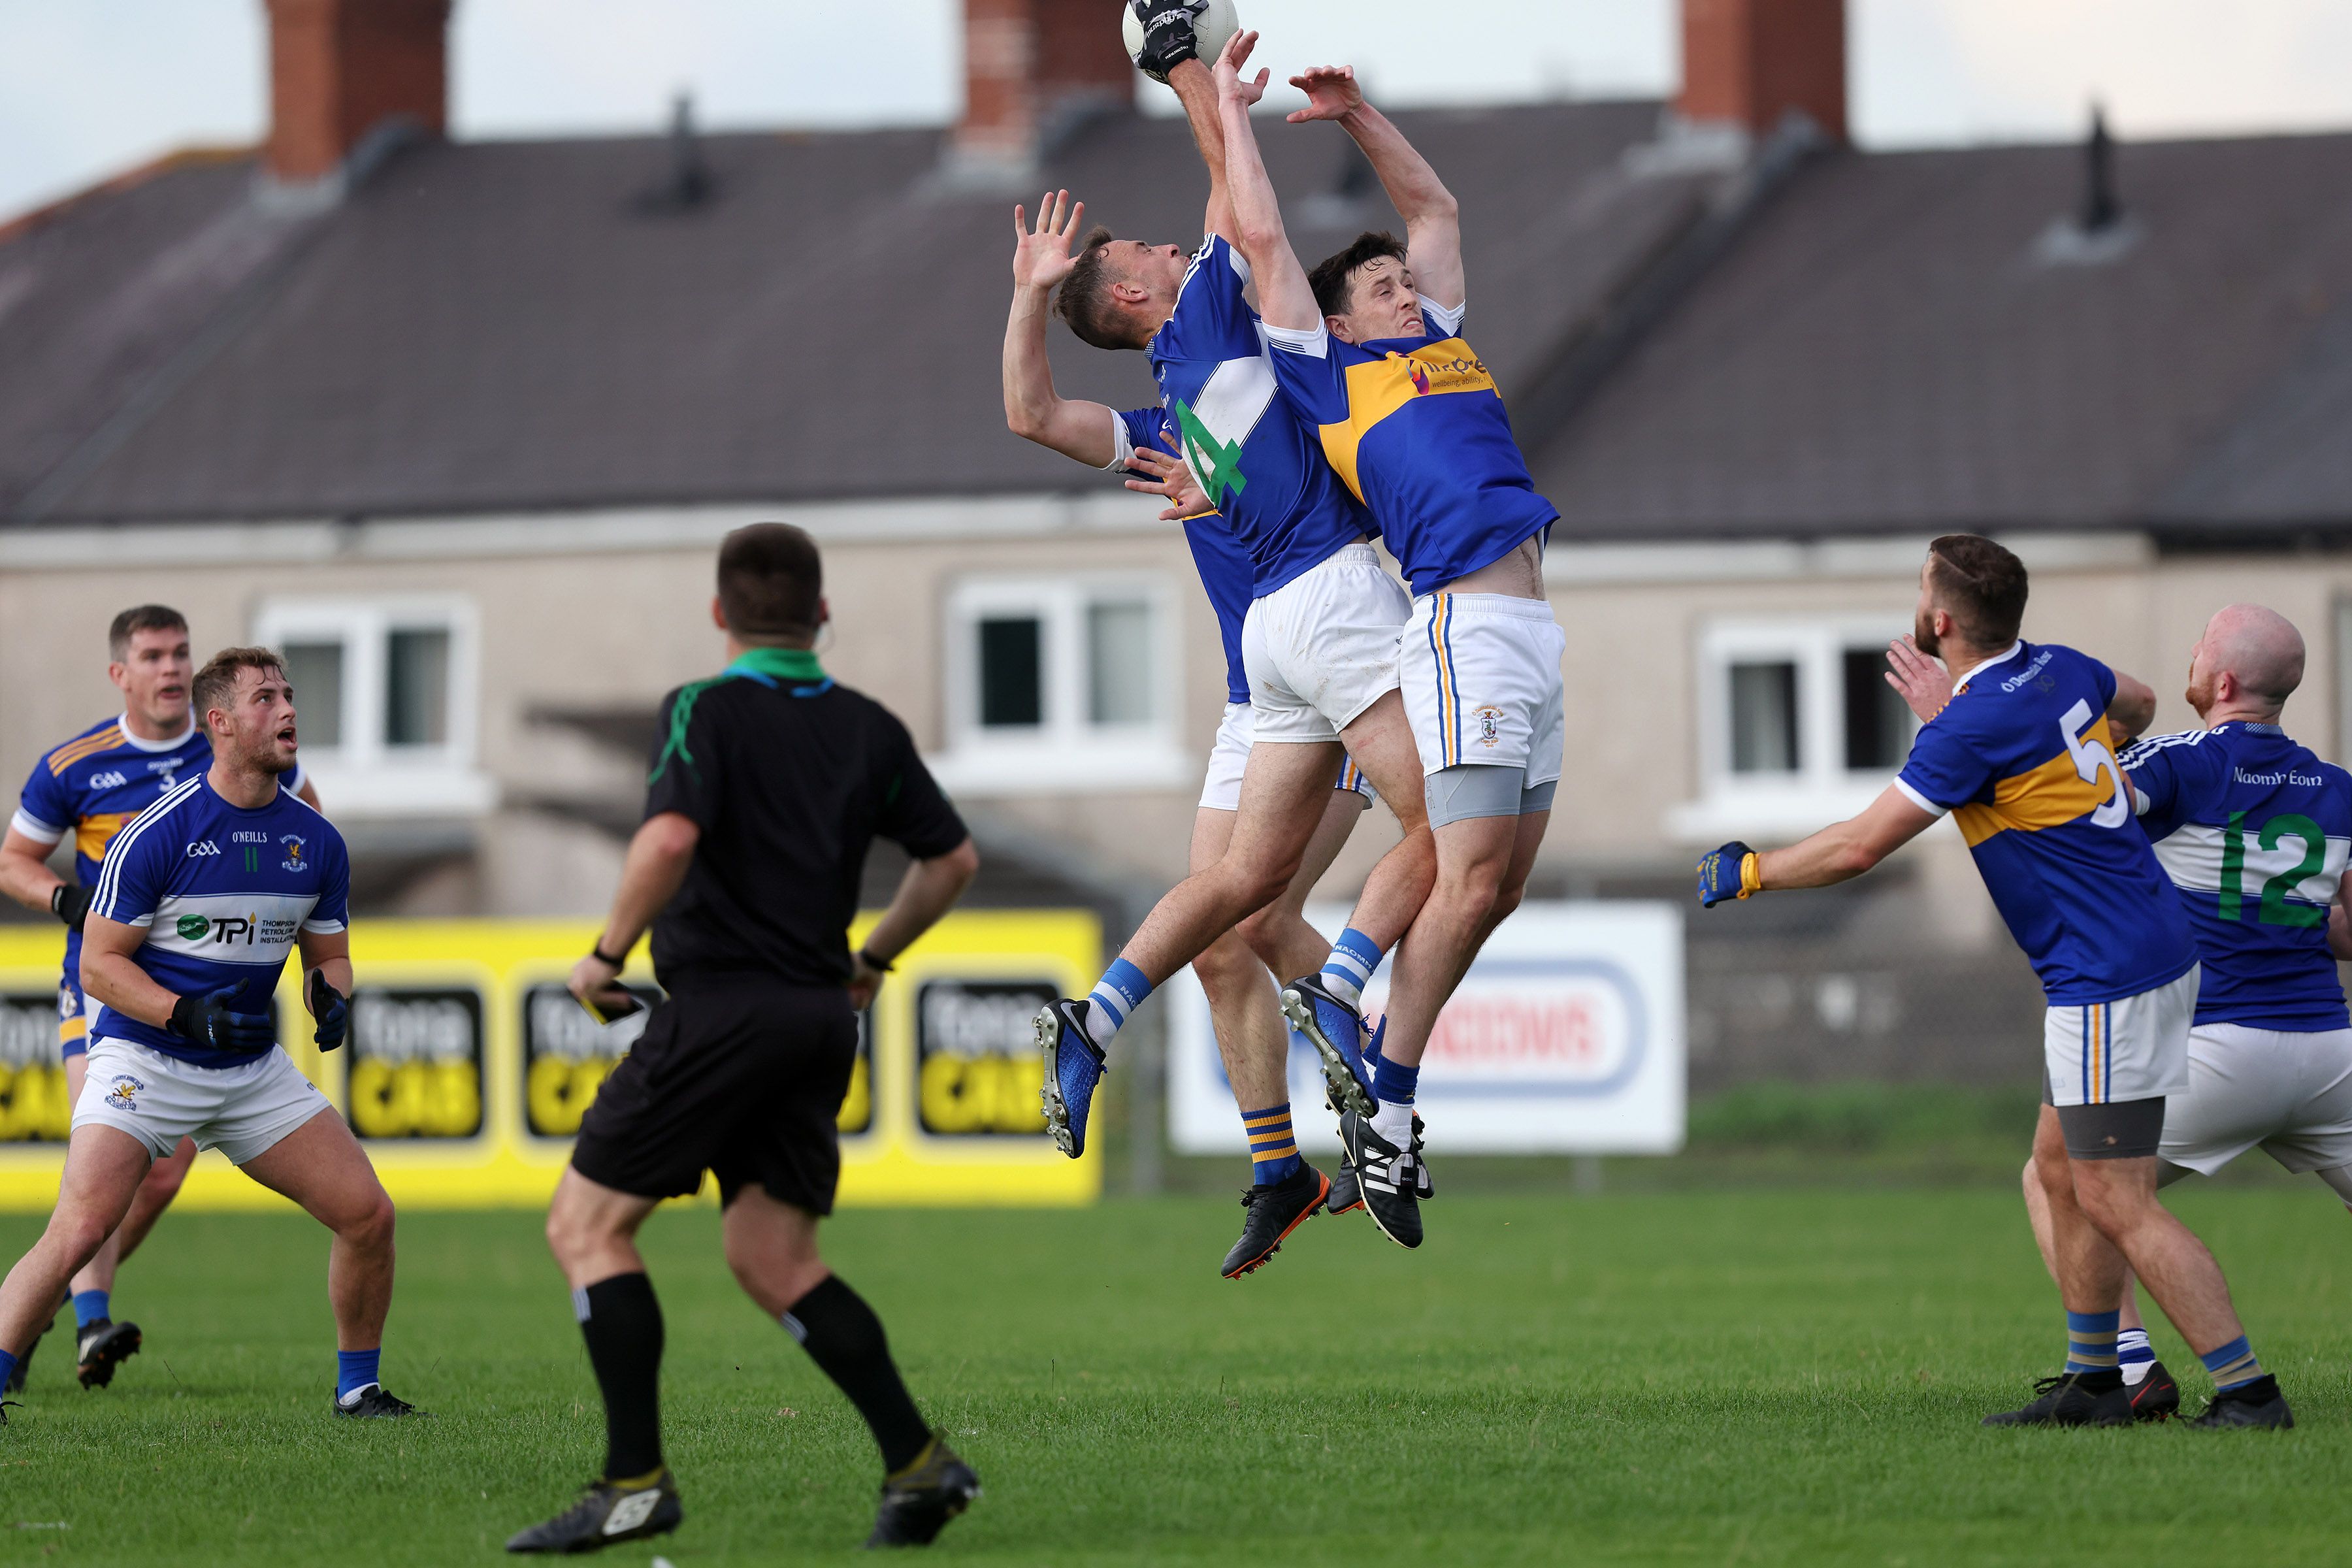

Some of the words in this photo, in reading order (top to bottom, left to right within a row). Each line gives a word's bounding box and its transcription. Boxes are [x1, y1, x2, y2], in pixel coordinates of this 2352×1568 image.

[1146, 12, 1182, 38] murphy's
[1432, 379, 1461, 387] wellbeing,
[1462, 376, 1483, 385] ability,
[1175, 397, 1247, 508] 4
[2060, 698, 2130, 828] 5
[89, 770, 127, 790] GAA
[159, 775, 176, 792] 3
[2233, 766, 2287, 785] Naomh
[2289, 770, 2323, 787] Eoin
[233, 831, 268, 843] O'NEILLS
[187, 840, 221, 858] GAA
[244, 847, 258, 873] 11
[2218, 811, 2327, 928] 12
[260, 935, 297, 943] INSTALLA
